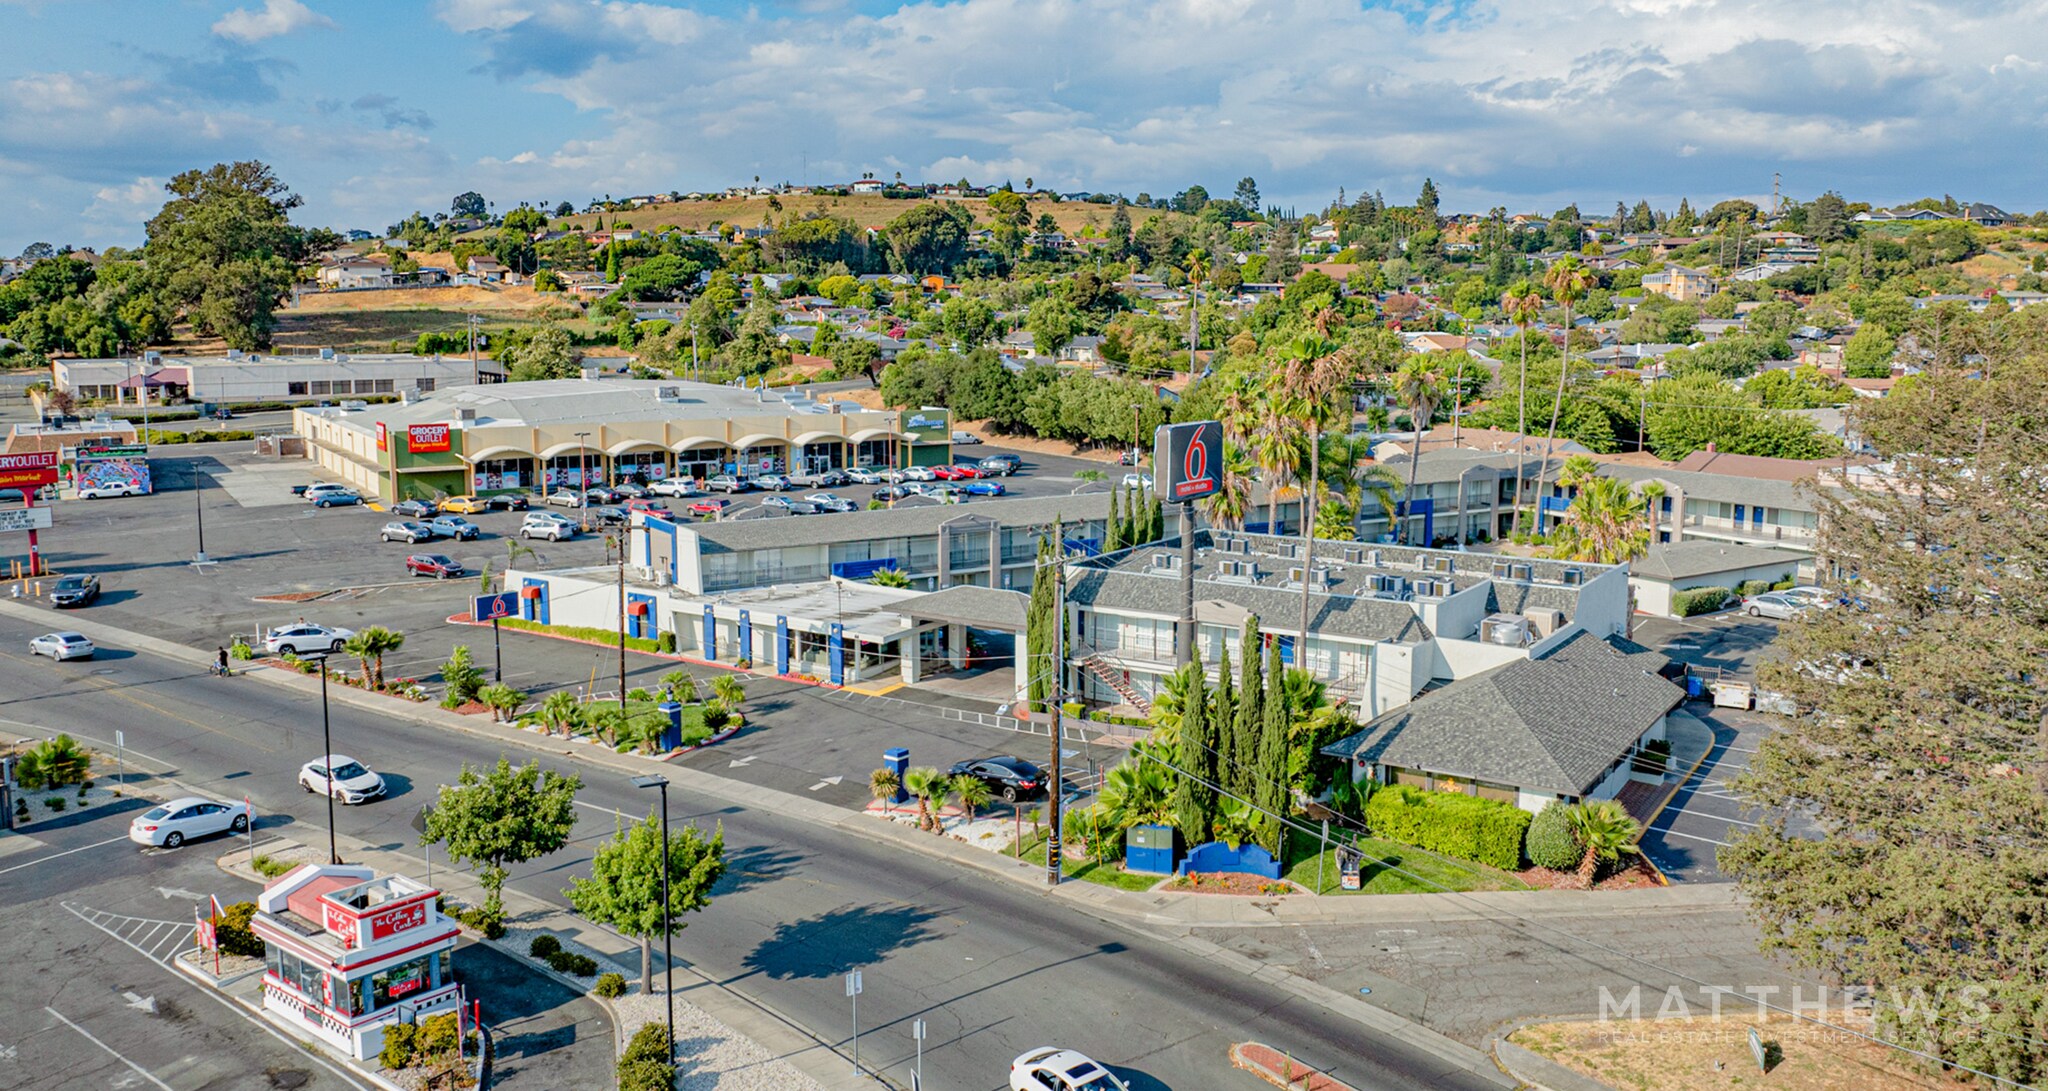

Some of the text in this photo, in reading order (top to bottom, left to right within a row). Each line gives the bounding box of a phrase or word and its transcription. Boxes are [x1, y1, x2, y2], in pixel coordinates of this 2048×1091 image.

[410, 426, 448, 436] GROCERY
[415, 434, 443, 443] OUTLET
[1184, 424, 1207, 481] 6
[492, 594, 505, 615] 6
[386, 911, 409, 924] Coffee
[393, 918, 414, 932] Curb
